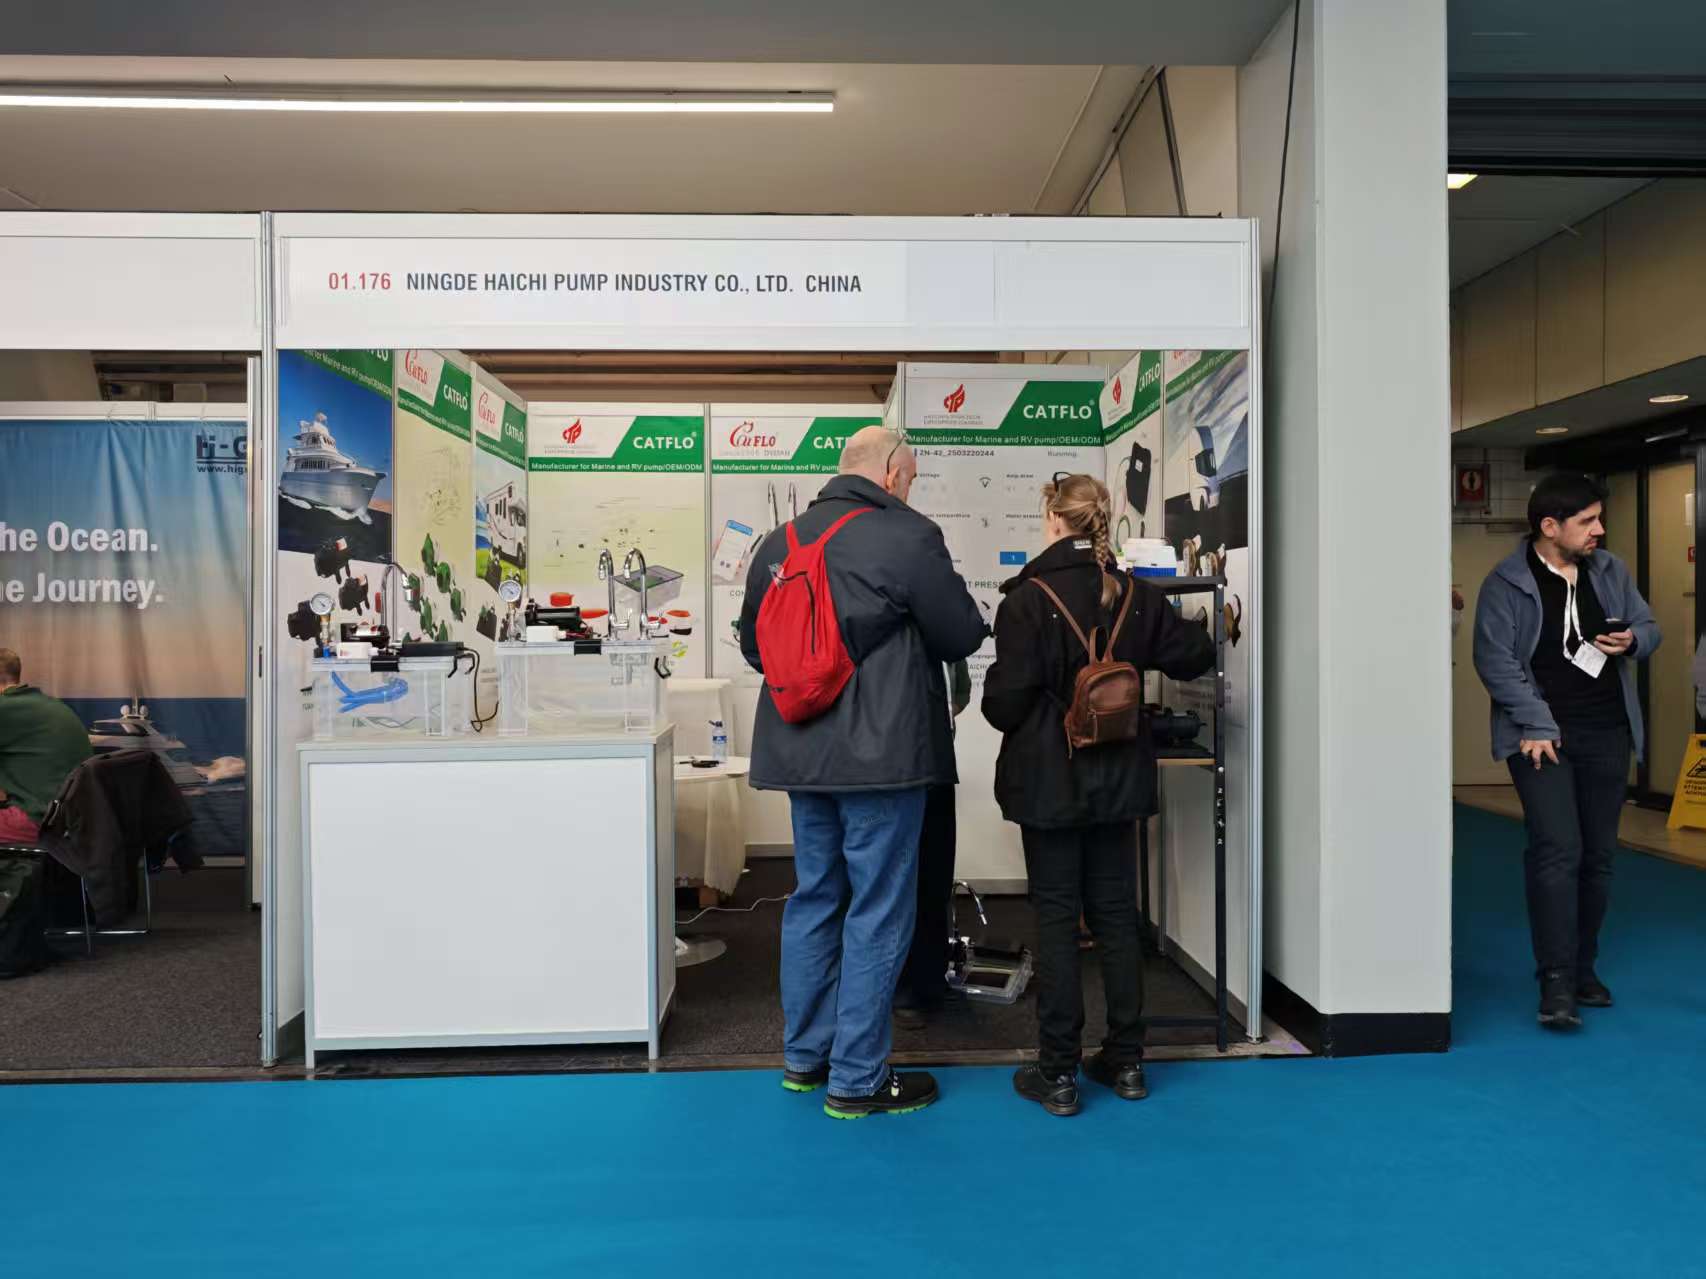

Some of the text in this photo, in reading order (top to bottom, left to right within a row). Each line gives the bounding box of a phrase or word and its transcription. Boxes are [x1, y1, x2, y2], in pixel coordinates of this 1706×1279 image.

[328, 272, 862, 295] 01.176 NINGDE HAICHI PUMP INDUSTRY CO., LTD. CHINA
[1139, 362, 1160, 393] CATFLO
[443, 384, 468, 411] CATFLO
[1023, 404, 1092, 420] CATFLO
[633, 436, 695, 450] CATFLO
[963, 435, 974, 443] for
[975, 435, 1003, 444] Marine
[1004, 435, 1019, 444] and
[1021, 436, 1034, 444] RV
[531, 463, 579, 471] Manufacturer
[591, 463, 615, 471] Marine
[617, 463, 630, 471] and
[631, 463, 642, 471] RV
[712, 464, 759, 472] Manufacturer
[760, 464, 770, 472] for
[770, 464, 795, 472] Marine
[796, 464, 809, 472] and
[810, 464, 820, 472] RV
[47, 520, 159, 552] Ocean.
[32, 572, 165, 610] Journey.
